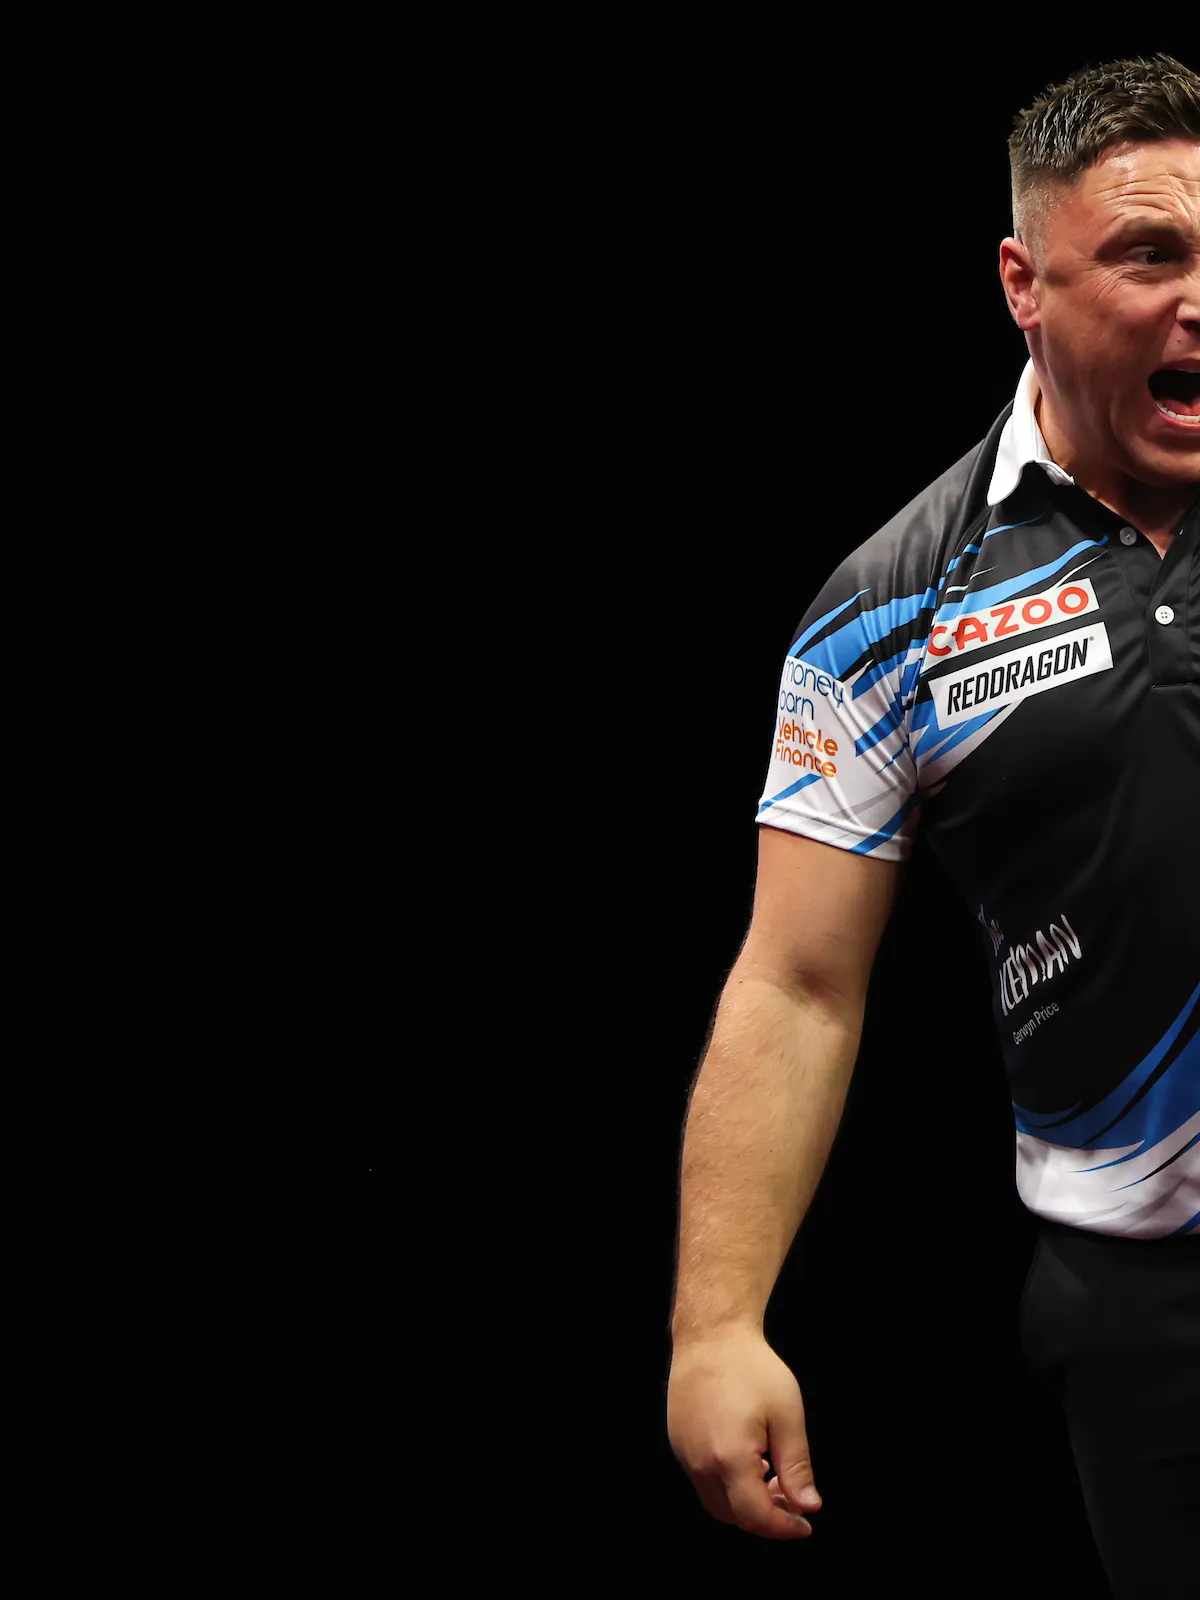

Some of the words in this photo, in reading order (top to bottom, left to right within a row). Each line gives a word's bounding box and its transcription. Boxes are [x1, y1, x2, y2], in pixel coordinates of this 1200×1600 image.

[927, 586, 1089, 656] CAZOO
[785, 660, 844, 709] money
[778, 716, 838, 757] Vehicle
[775, 739, 837, 778] Finance
[1012, 1018, 1037, 1045] Gerwyn
[1033, 1002, 1060, 1025] Price
